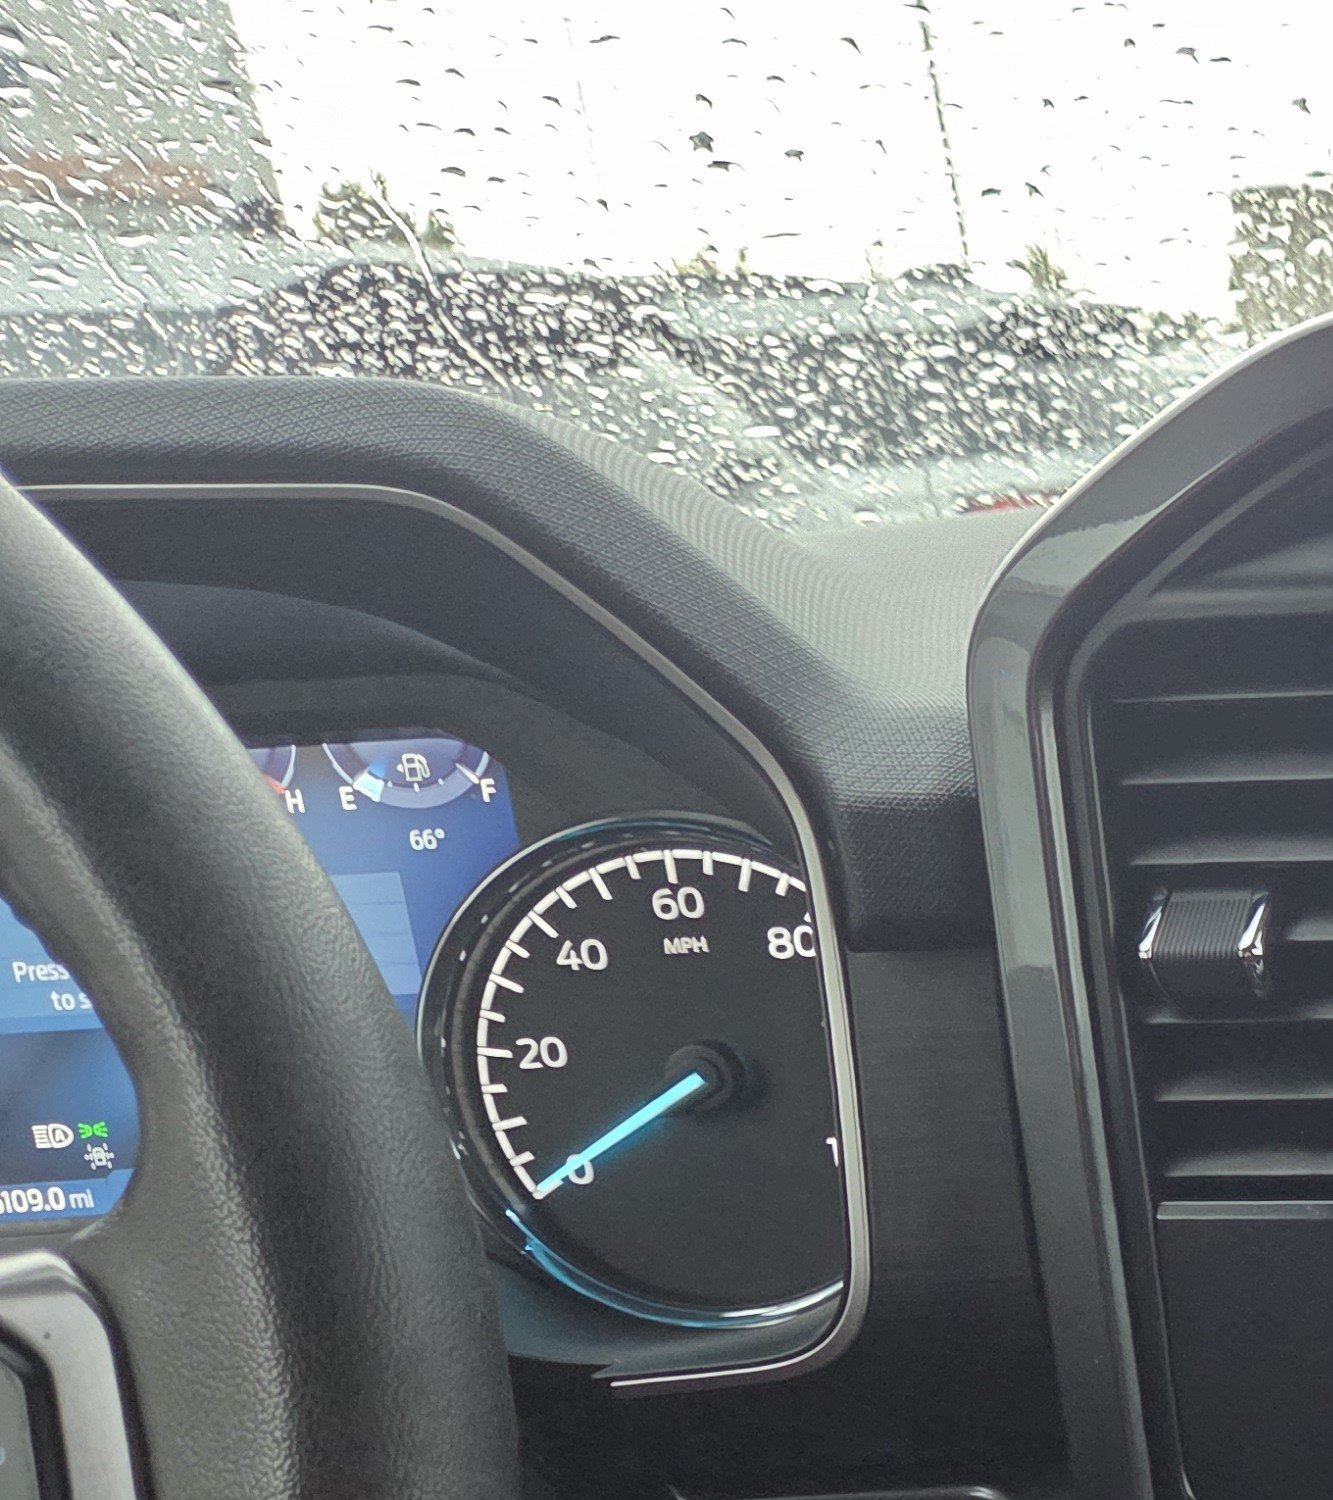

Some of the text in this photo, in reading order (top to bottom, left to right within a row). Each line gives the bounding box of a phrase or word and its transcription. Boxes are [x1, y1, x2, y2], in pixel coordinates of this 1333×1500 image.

[284, 788, 306, 814] H
[338, 786, 358, 811] E
[480, 778, 496, 803] F
[651, 886, 705, 921] 60
[556, 937, 608, 973] 40
[663, 934, 709, 956] MPH
[12, 961, 71, 983] Press
[50, 990, 76, 1011] to
[516, 1036, 567, 1070] 20
[0, 1186, 95, 1214] 109.0 mi
